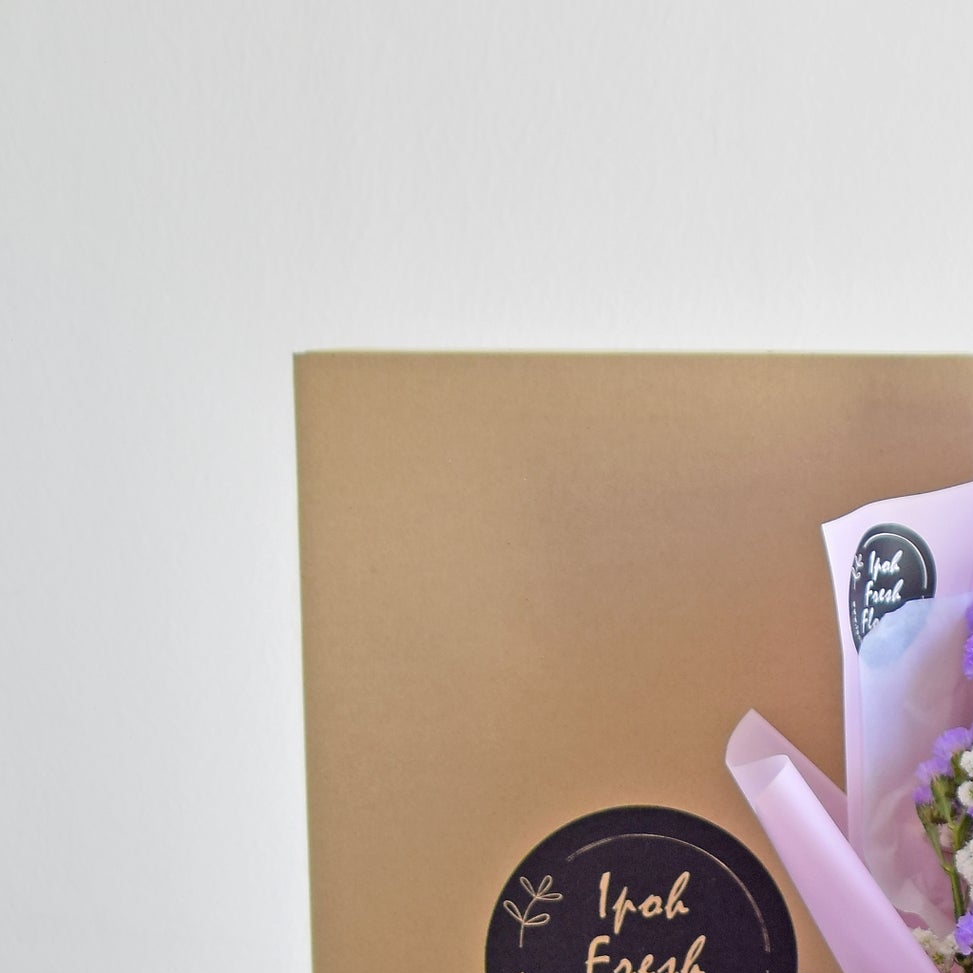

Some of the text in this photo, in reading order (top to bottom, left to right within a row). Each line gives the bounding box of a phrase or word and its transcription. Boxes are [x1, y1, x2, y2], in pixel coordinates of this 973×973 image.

[868, 550, 903, 581] Ipoh
[865, 578, 904, 606] Fresh
[599, 871, 691, 934] Ipoh
